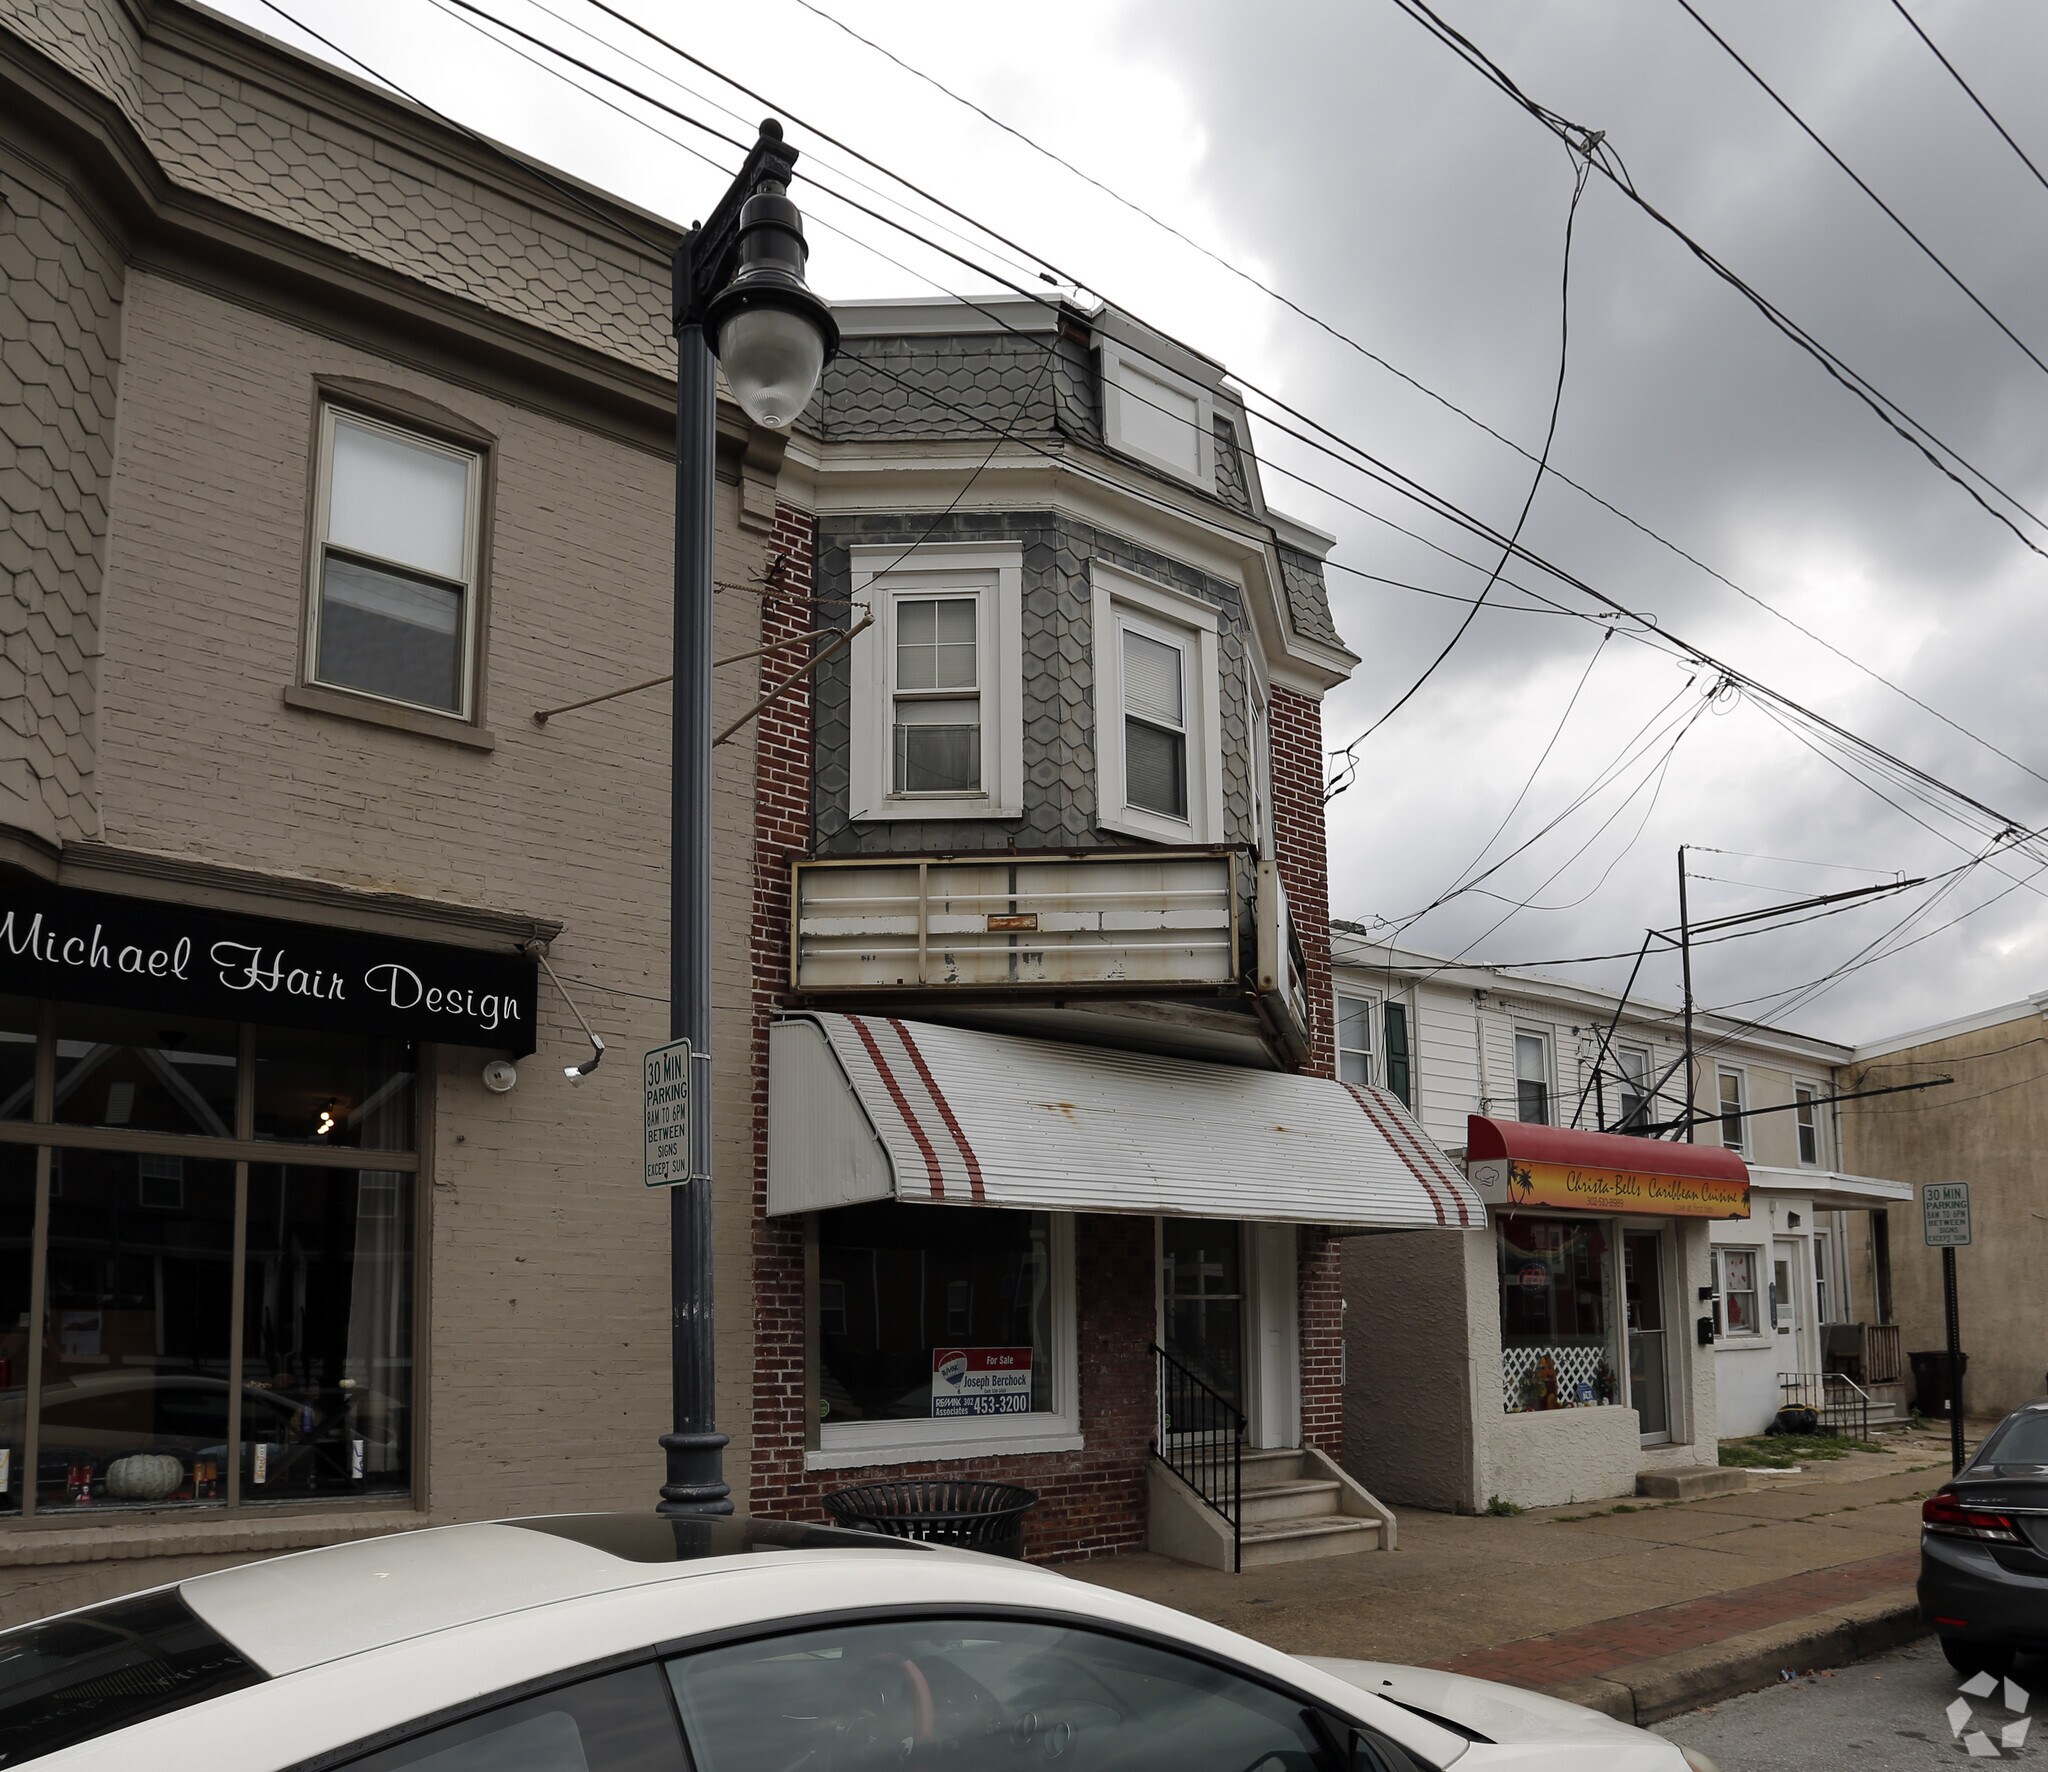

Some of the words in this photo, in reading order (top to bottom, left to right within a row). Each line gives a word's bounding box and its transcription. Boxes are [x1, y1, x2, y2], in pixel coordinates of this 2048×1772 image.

[0, 911, 191, 981] Michael
[210, 940, 346, 1000] Hair
[364, 964, 521, 1030] Design
[648, 1061, 661, 1087] 30
[663, 1054, 685, 1083] MIN.
[647, 1082, 687, 1107] PARKING
[646, 1109, 660, 1128] 8AM
[661, 1106, 671, 1125] TO
[673, 1103, 686, 1121] 6PM
[647, 1125, 685, 1144] BETWEEN
[657, 1143, 678, 1158] SIGNS
[647, 1162, 669, 1177] EXCEPT
[672, 1160, 687, 1174] SUN.
[1566, 1170, 1641, 1197] Christa-Bells
[1648, 1177, 1699, 1201] Caribbean
[1701, 1182, 1737, 1203] Cuisine
[1927, 1189, 1940, 1201] 30
[1943, 1187, 1965, 1200] MIN.
[1926, 1200, 1967, 1210] PARKING
[1927, 1211, 1939, 1219] 8AM
[1943, 1210, 1950, 1218] TO
[1953, 1210, 1966, 1218] 6PM
[1928, 1234, 1951, 1242] EXCEPT
[986, 1355, 998, 1365] For
[999, 1355, 1014, 1365] Sale
[942, 1363, 959, 1377] RE/MAX
[963, 1375, 990, 1390] Joseph
[992, 1374, 1027, 1387] Berchock
[935, 1398, 961, 1408] RE/MAX
[963, 1397, 974, 1406] 302
[973, 1395, 1027, 1414] 453-3200
[935, 1406, 969, 1417] Associates
